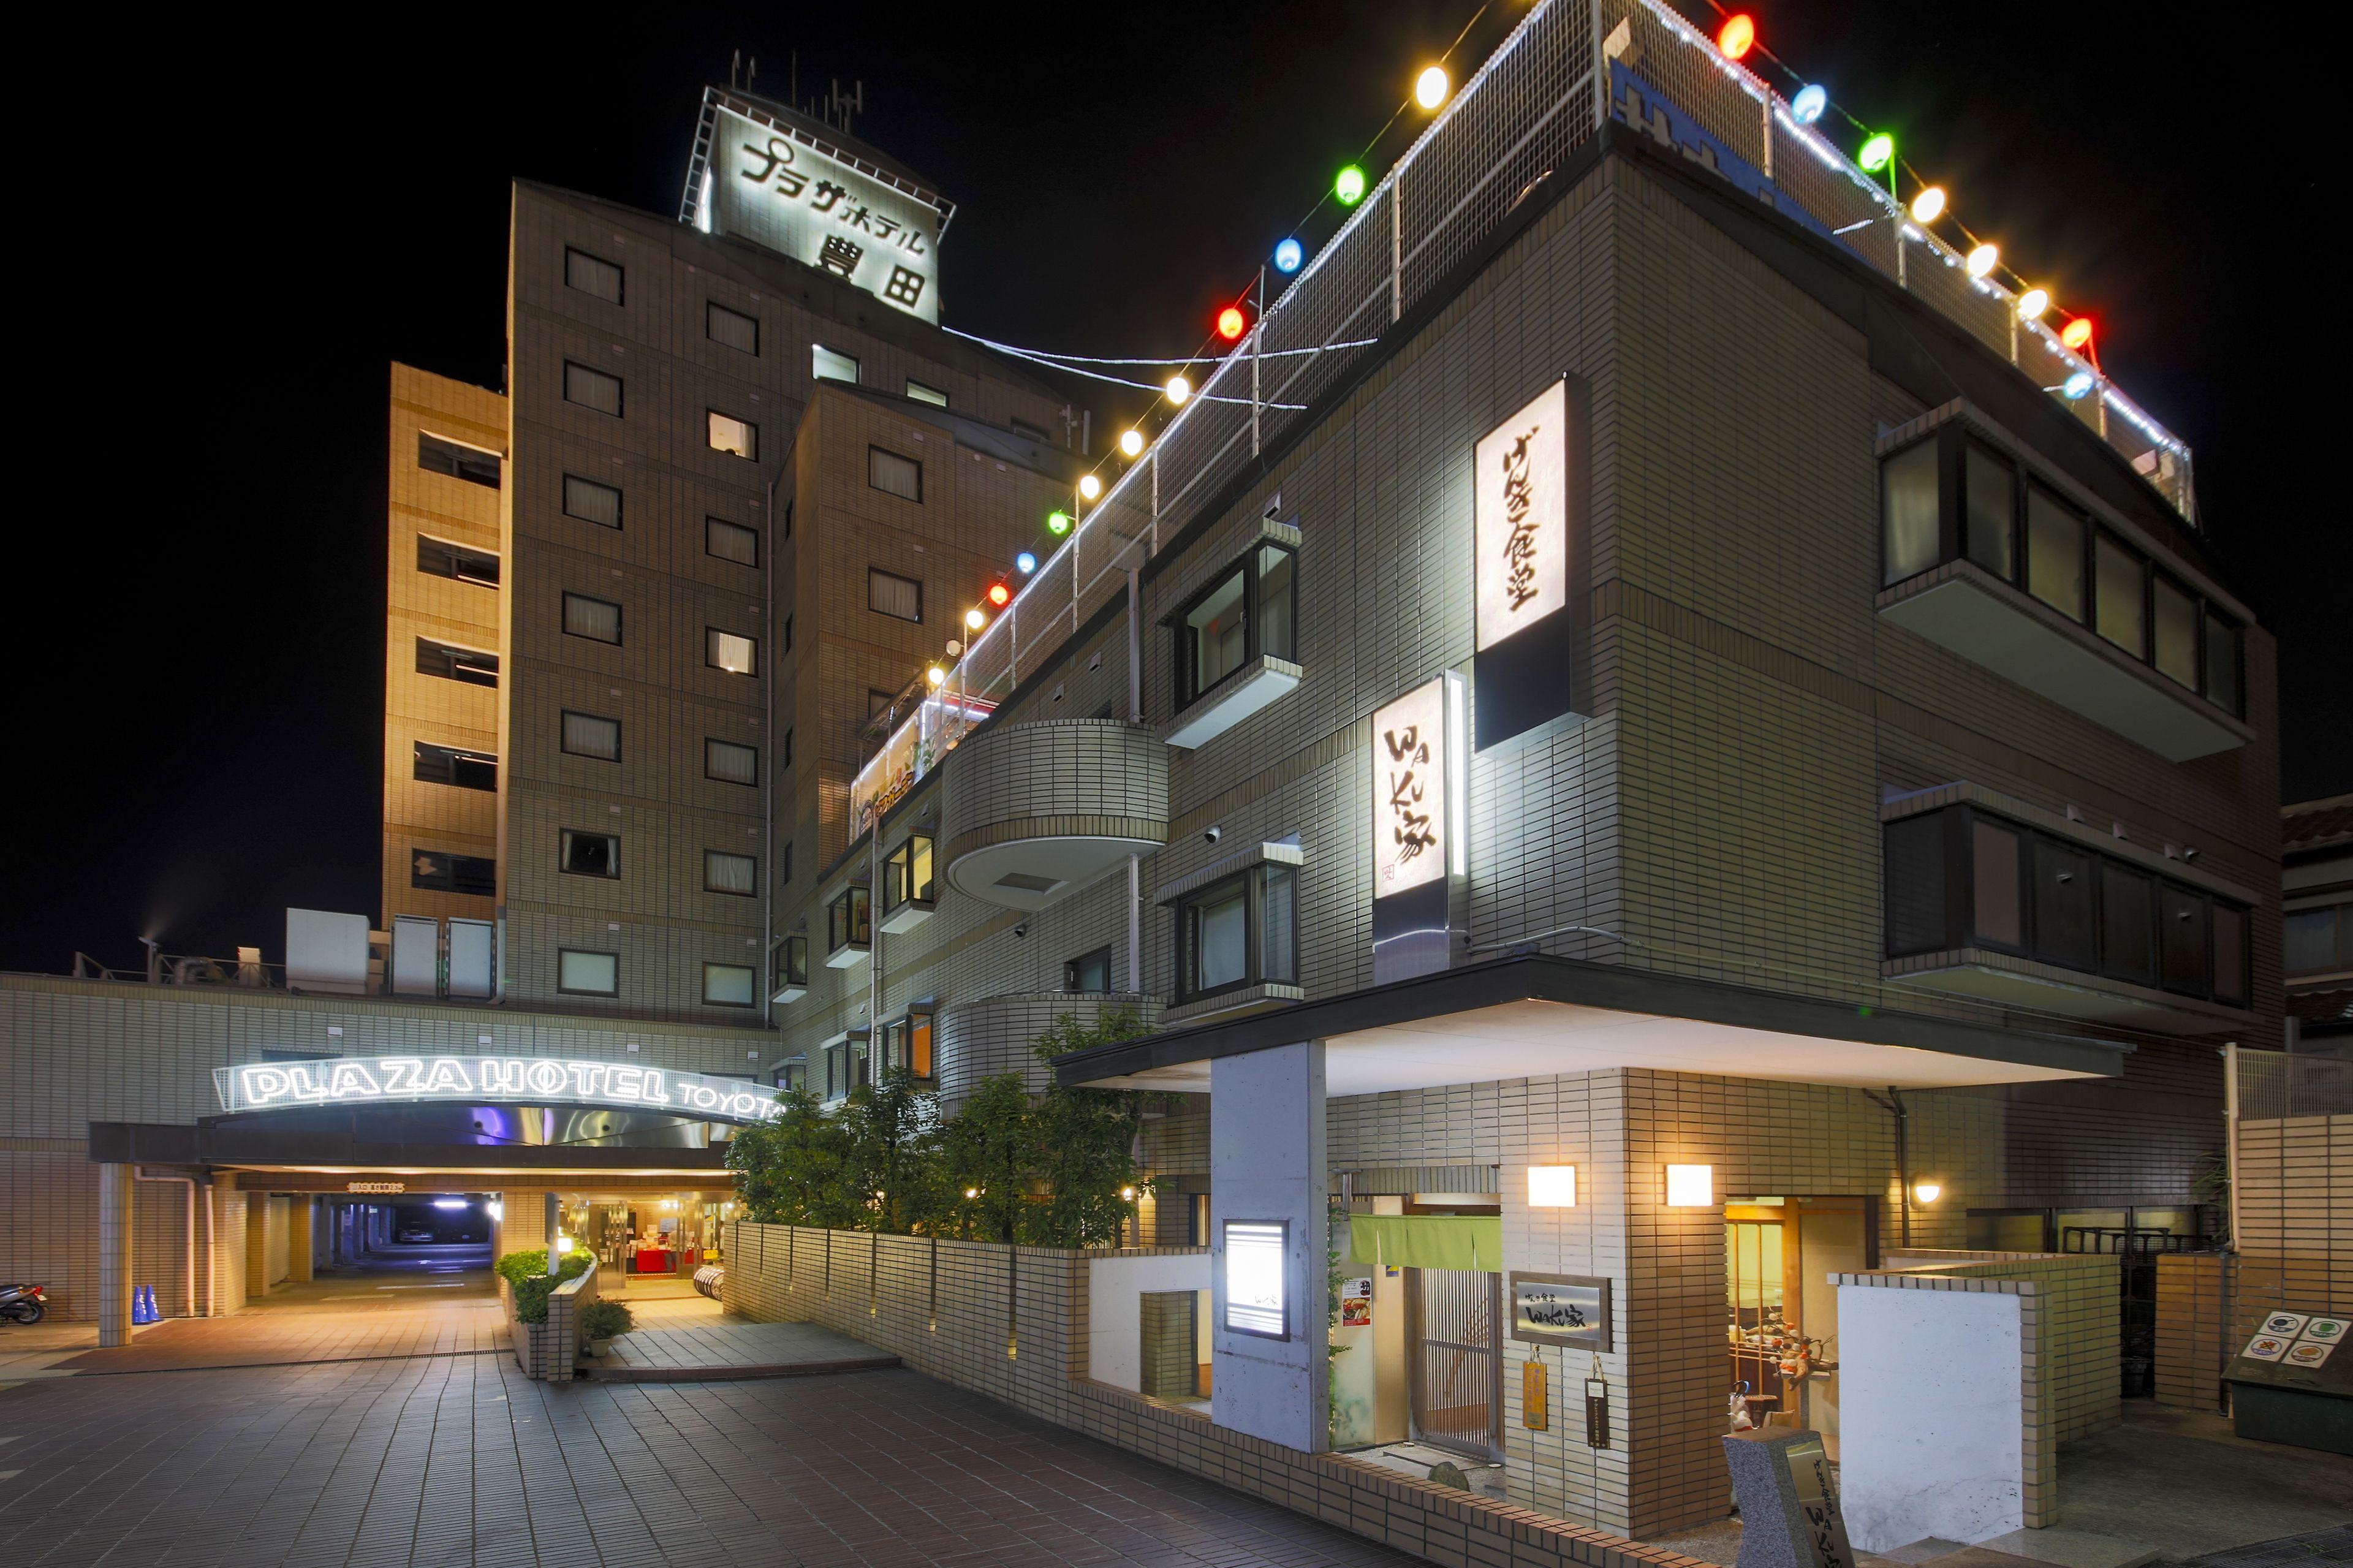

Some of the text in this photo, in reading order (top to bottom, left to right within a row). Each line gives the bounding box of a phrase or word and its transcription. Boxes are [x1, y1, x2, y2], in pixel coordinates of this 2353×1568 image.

[741, 138, 926, 256] プラザホテル
[243, 1059, 473, 1103] PLAZA
[481, 1060, 669, 1102] HOTEL
